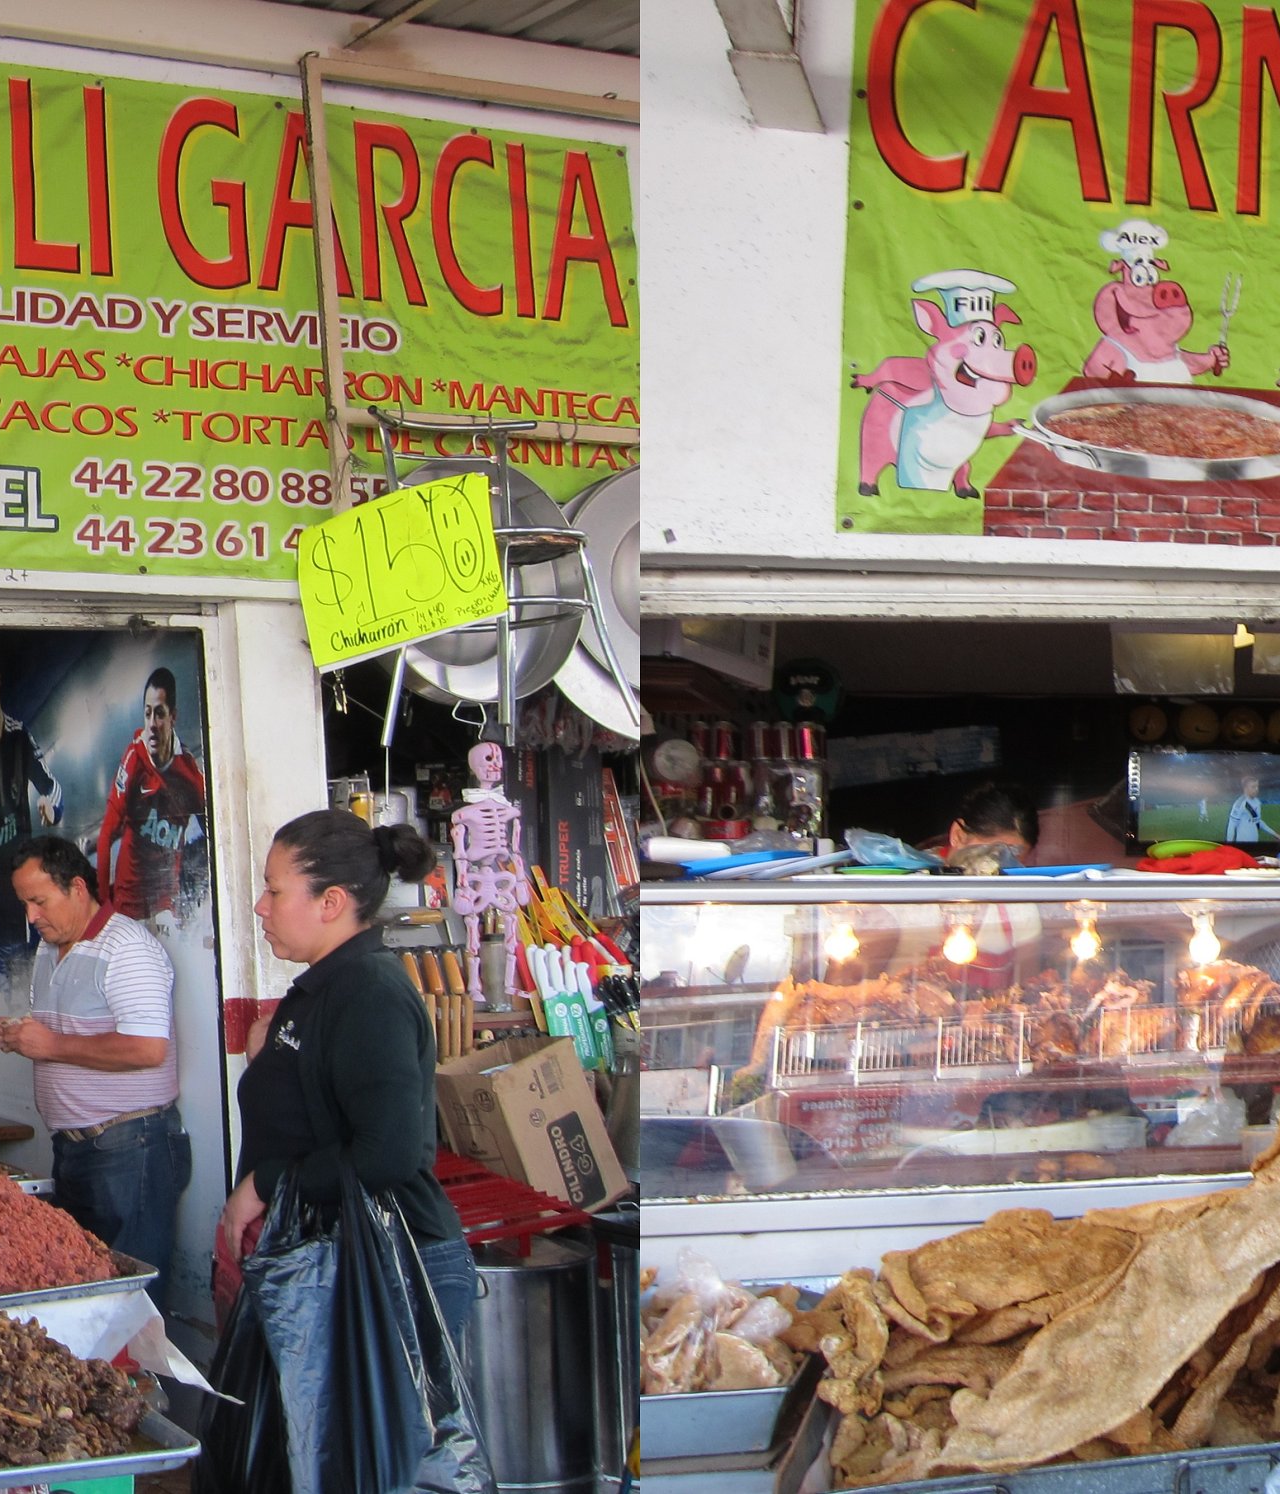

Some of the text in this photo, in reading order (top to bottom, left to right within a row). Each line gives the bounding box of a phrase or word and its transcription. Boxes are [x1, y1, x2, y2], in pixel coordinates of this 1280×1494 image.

[158, 96, 629, 328] GARCIA
[1117, 231, 1160, 247] Alex
[153, 302, 182, 335] Y
[954, 296, 994, 313] Fili
[74, 461, 133, 498] 44
[145, 465, 202, 499] 22
[213, 469, 269, 502] 80
[281, 471, 332, 505] 88
[77, 518, 135, 553] 44
[147, 521, 203, 556] 23
[215, 524, 266, 558] 61
[558, 820, 569, 885] TRUPER
[550, 1125, 583, 1204] CILINDRO
